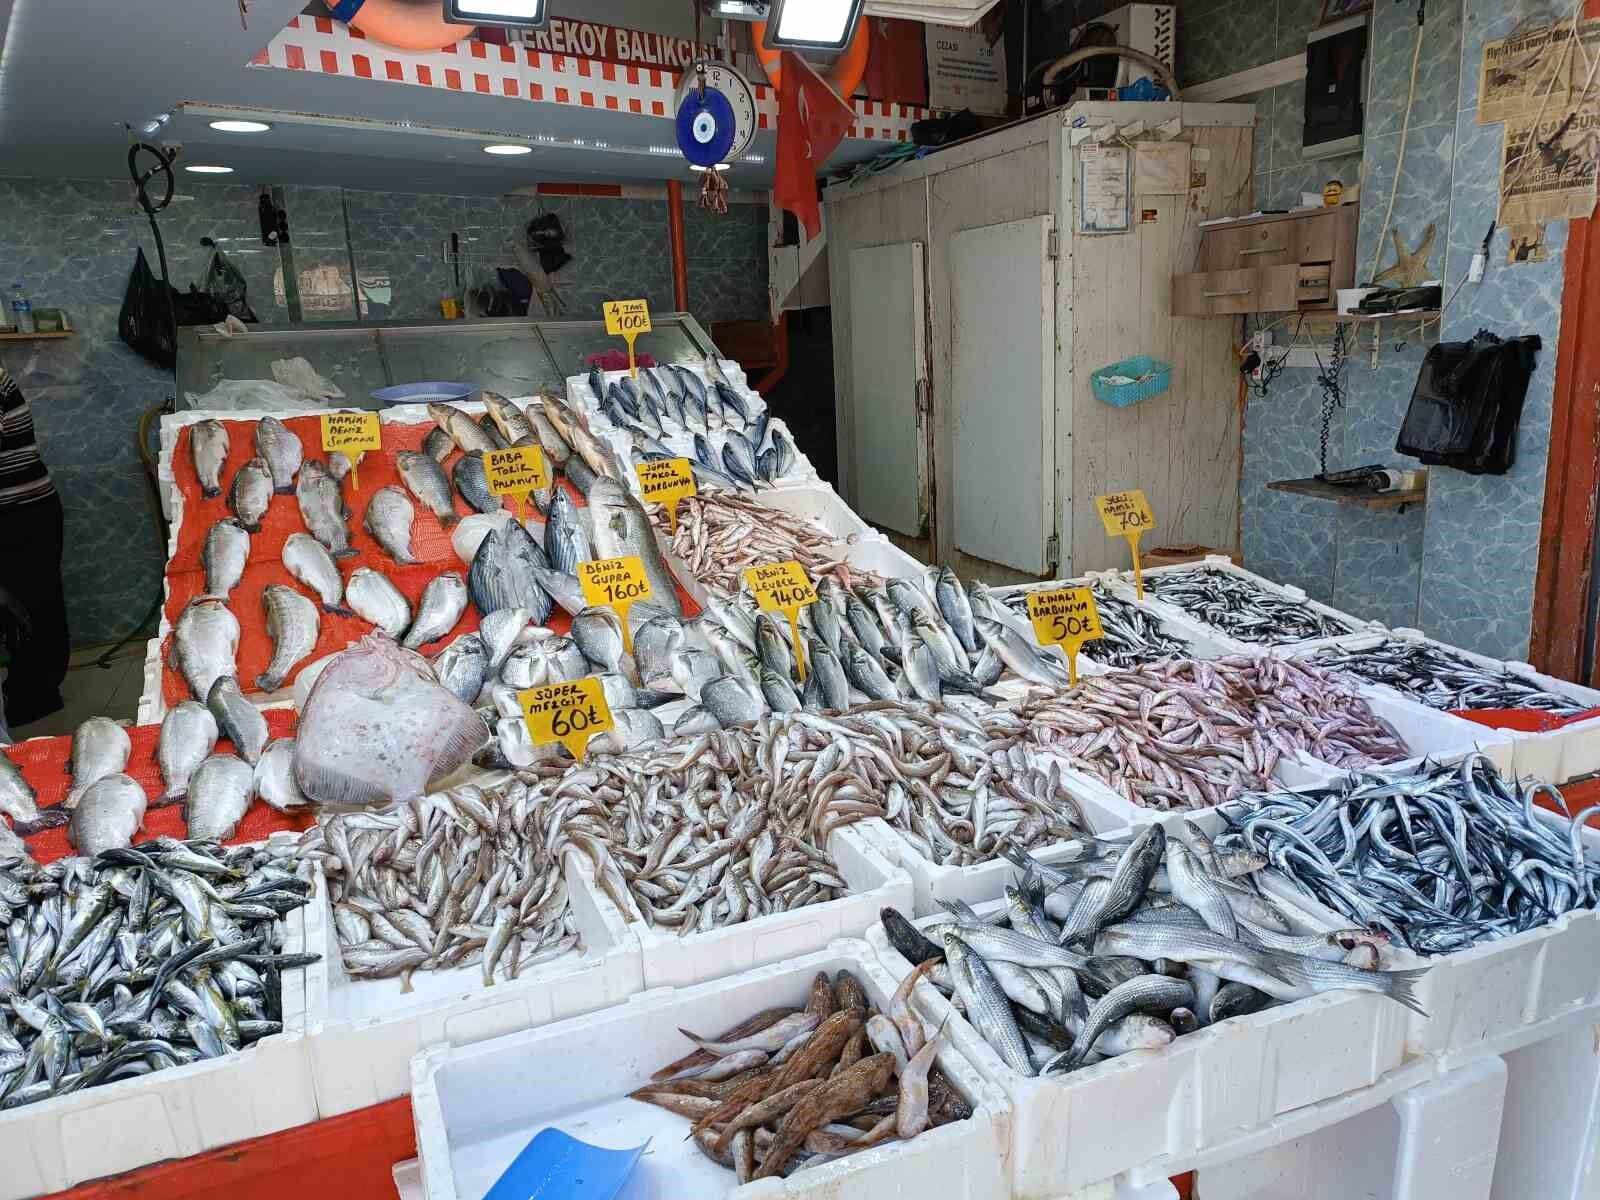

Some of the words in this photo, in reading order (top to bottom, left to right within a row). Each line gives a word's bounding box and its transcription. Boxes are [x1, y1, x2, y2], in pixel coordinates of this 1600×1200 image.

[744, 110, 750, 121] 3
[609, 303, 620, 316] 4
[491, 452, 523, 466] BABA
[493, 474, 541, 491] PALAMUT
[644, 476, 691, 494] BARBUNYA
[586, 561, 625, 574] DENİZ
[1033, 602, 1088, 617] BARBUNYA
[535, 684, 583, 700] SÜPER
